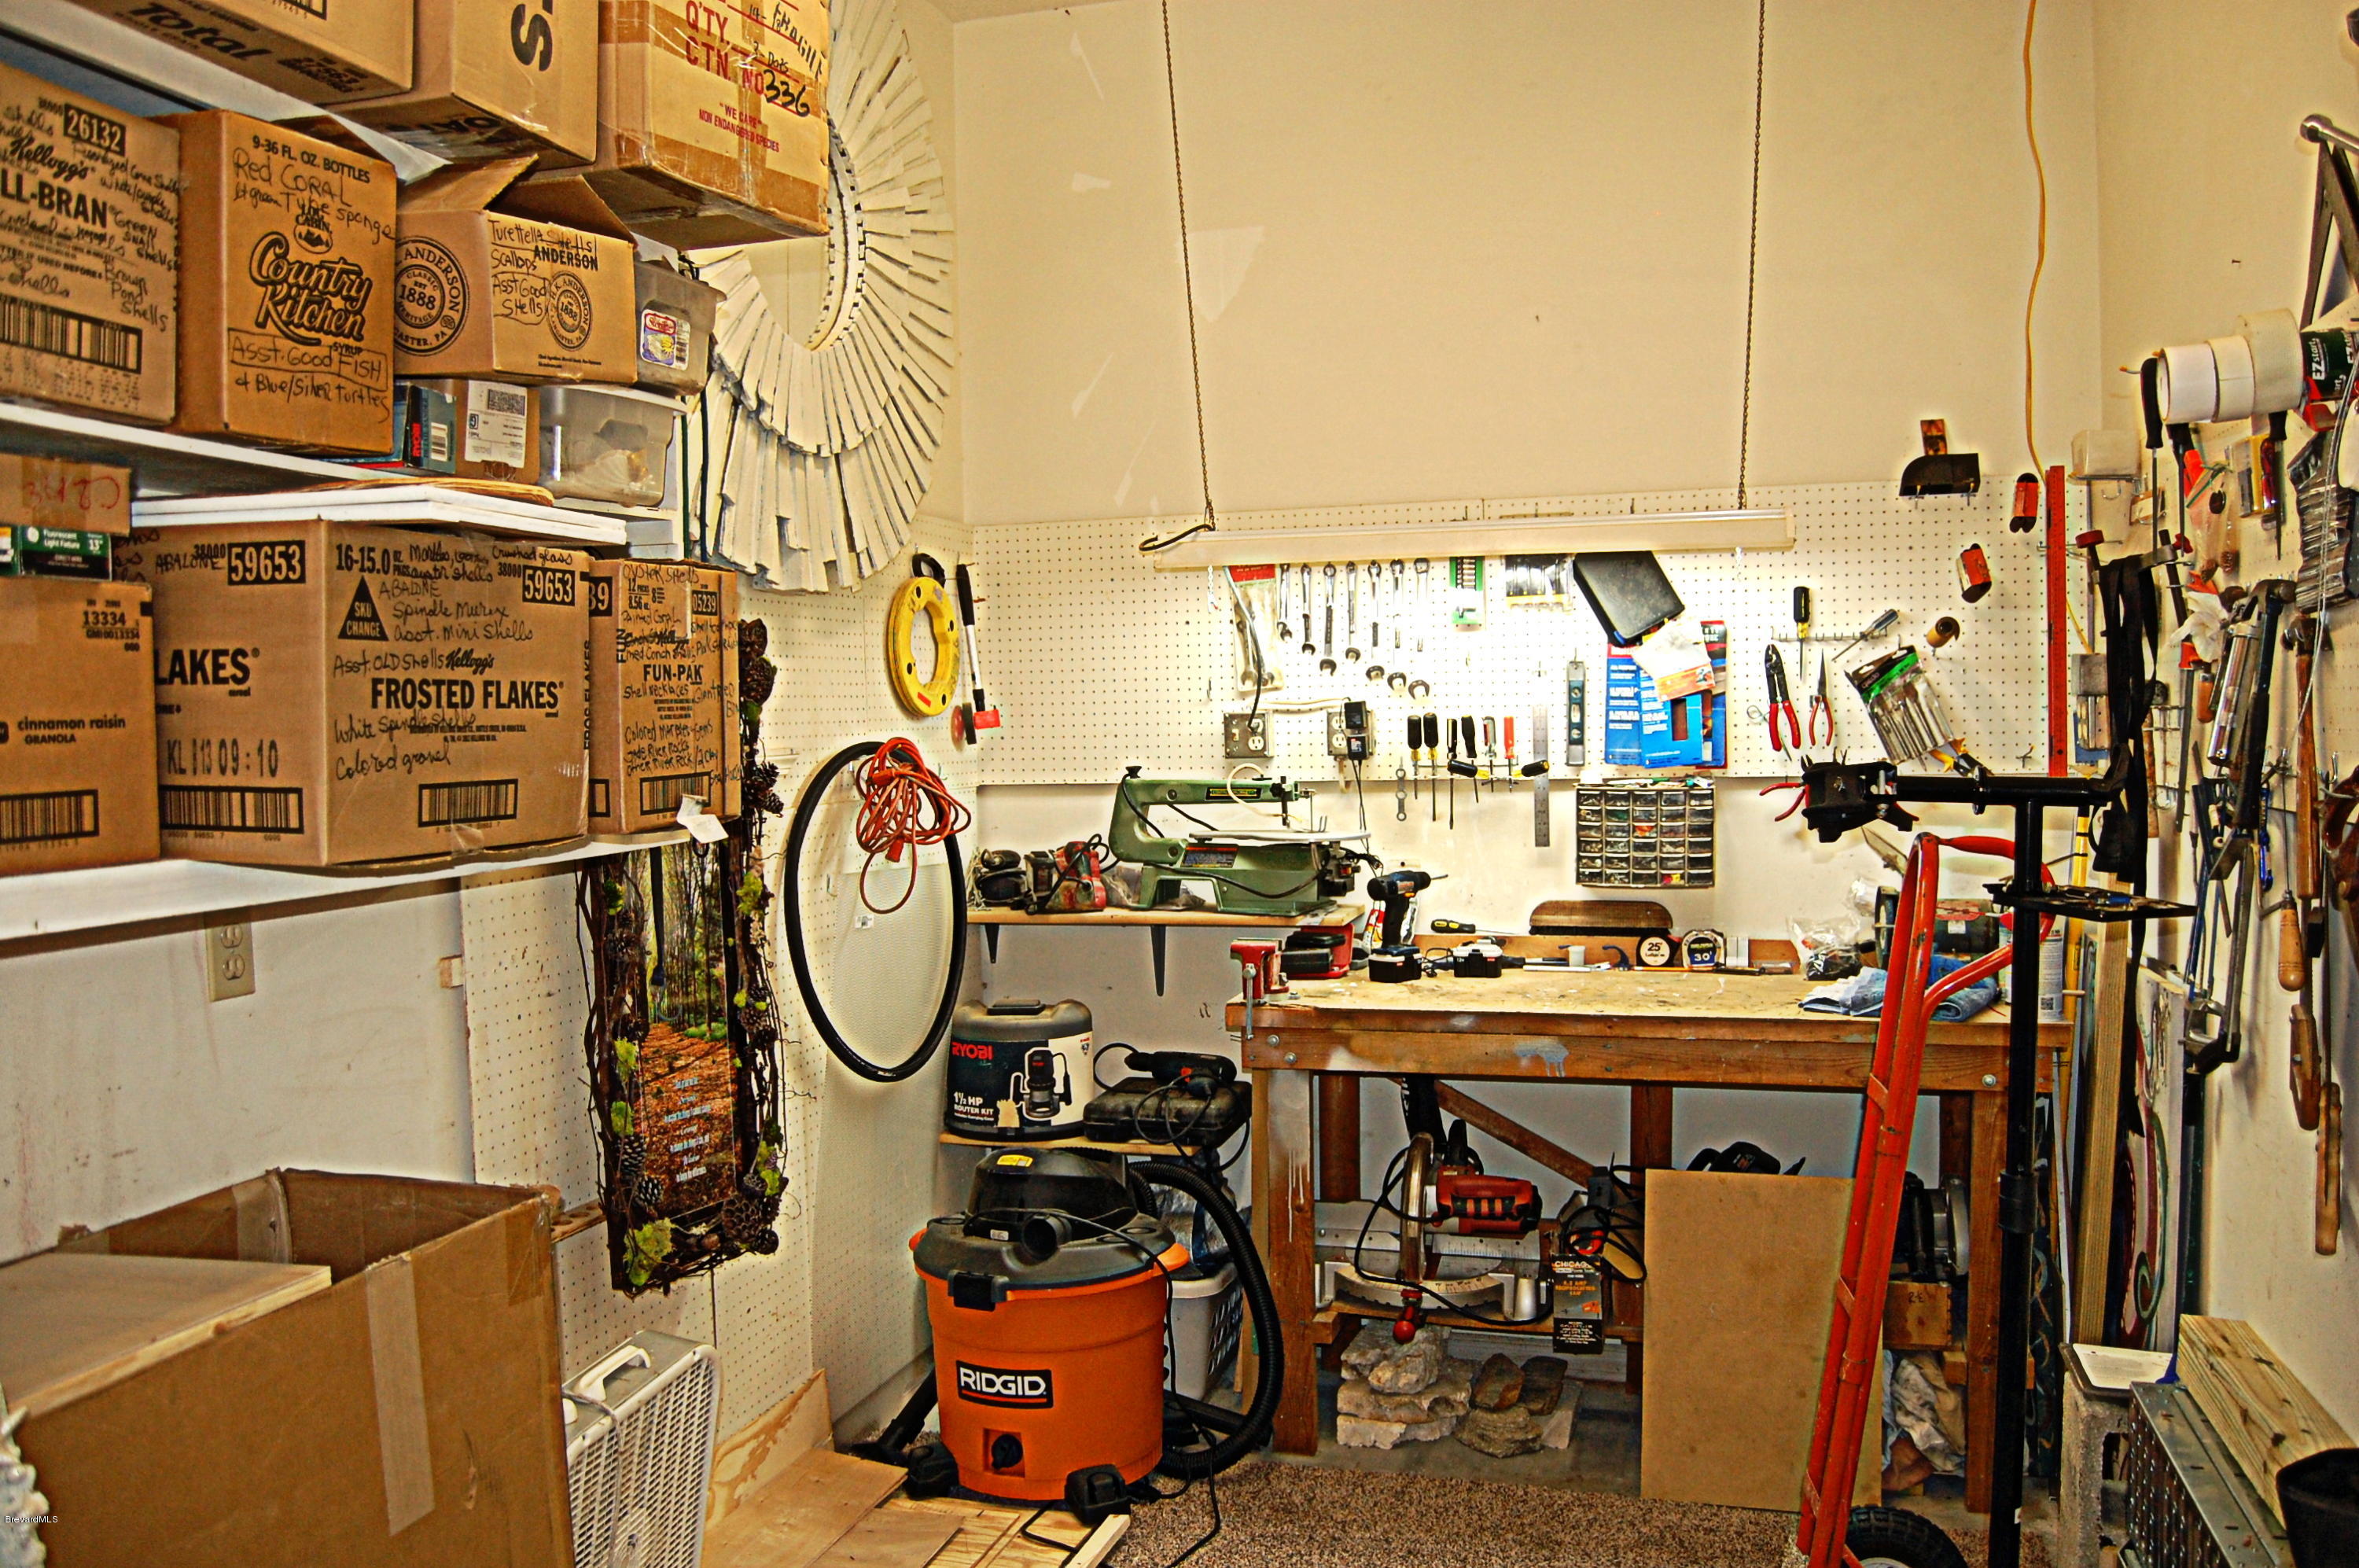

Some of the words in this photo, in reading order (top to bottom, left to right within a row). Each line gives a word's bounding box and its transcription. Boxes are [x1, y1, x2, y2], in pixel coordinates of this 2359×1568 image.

[764, 69, 810, 117] 336
[67, 109, 122, 153] 26132
[756, 133, 780, 153] SPECIES
[233, 147, 272, 187] Red
[252, 135, 279, 155] 9-36
[323, 157, 370, 184] BOTTLES
[1, 167, 108, 229] LL-BRAN
[249, 231, 374, 313] Country
[534, 245, 598, 271] ANDERSON
[404, 246, 461, 314] ANDERSON
[399, 284, 436, 311] 1888
[255, 283, 366, 346] Kitchen
[434, 330, 447, 342] PA
[230, 544, 302, 582] 59653
[336, 543, 391, 575] 16-15.0
[498, 561, 522, 579] 38000
[524, 569, 573, 603] 59653
[82, 610, 127, 627] 13334
[354, 602, 372, 617] SKU
[692, 594, 716, 613] 05239
[346, 620, 381, 637] CHANGE
[445, 646, 495, 675] Kellogg's
[616, 628, 627, 664] FUN
[155, 647, 251, 686] LAKES
[643, 664, 705, 682] FUN-PAK
[371, 677, 475, 709] FROSTED
[482, 679, 559, 709] FLAKES
[17, 716, 86, 731] cinnamon
[89, 714, 127, 729] raisin
[24, 733, 76, 745] GRANOLA
[951, 1041, 995, 1061] RYOBI
[954, 1104, 980, 1114] ROUTER
[968, 1095, 983, 1106] HP
[959, 1366, 1047, 1397] RIDGID
